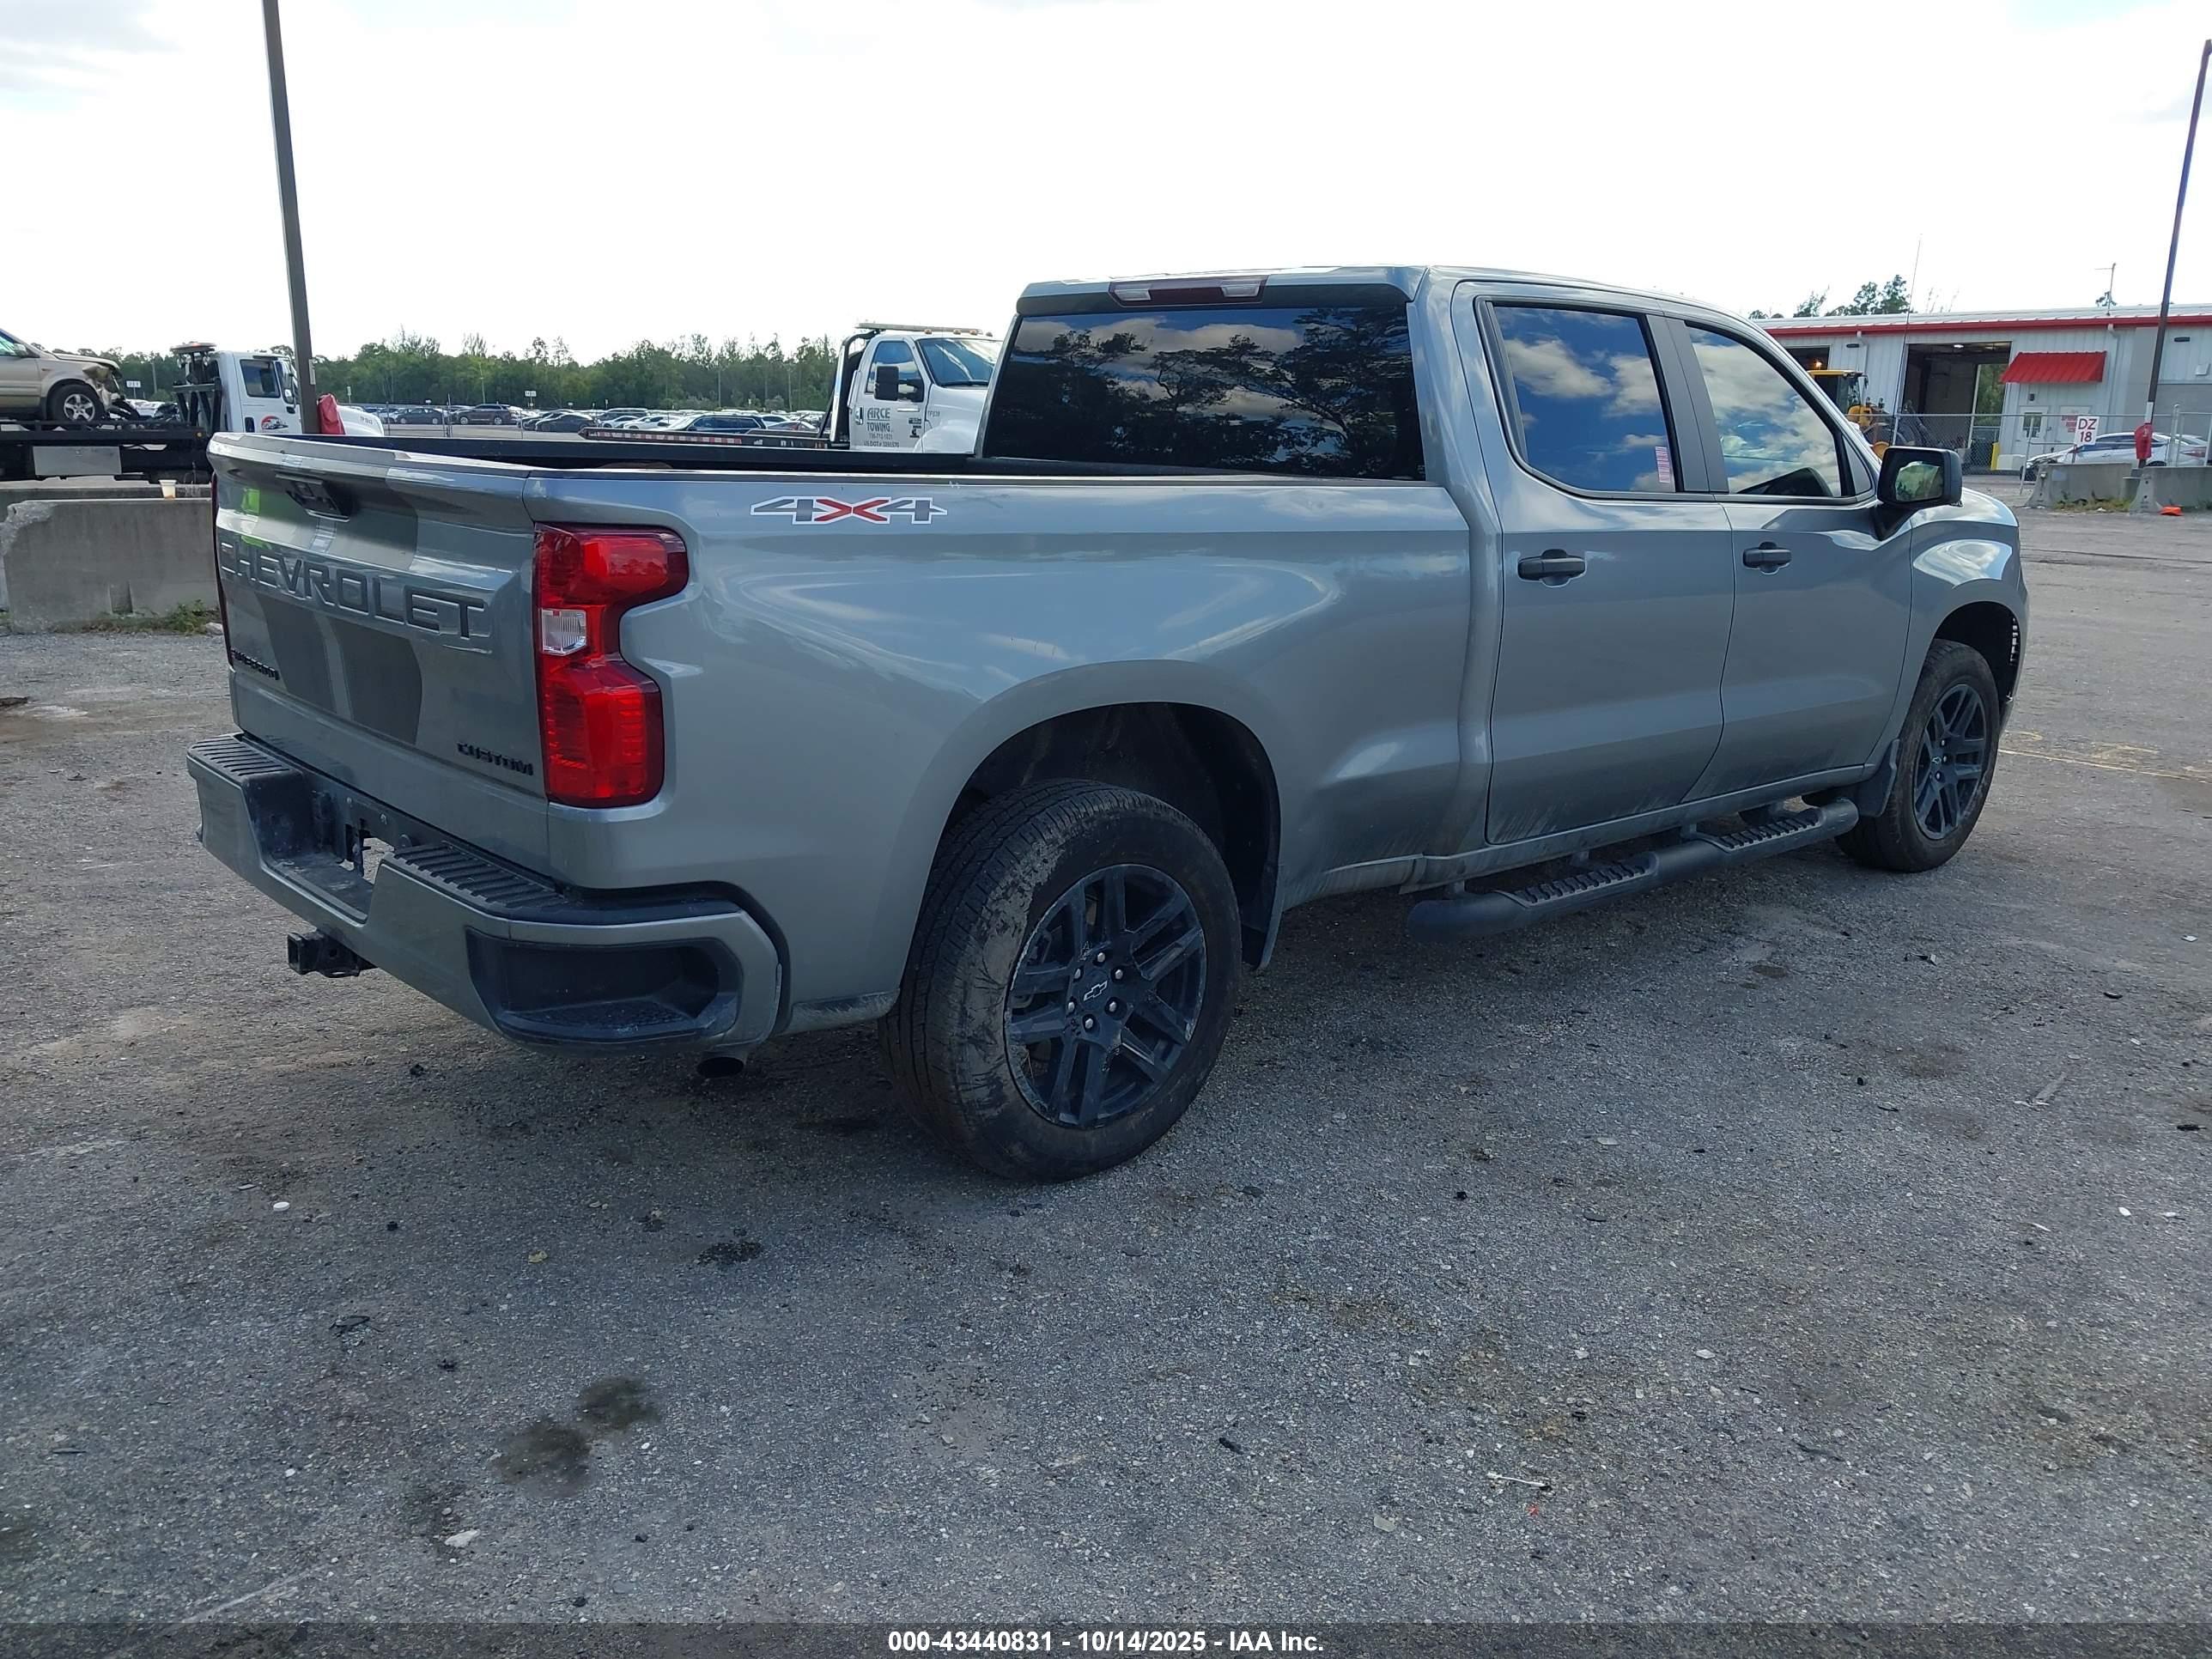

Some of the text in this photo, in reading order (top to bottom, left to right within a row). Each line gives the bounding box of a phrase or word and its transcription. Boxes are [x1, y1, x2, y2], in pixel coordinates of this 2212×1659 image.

[867, 408, 890, 419] ARCE
[866, 422, 890, 432] TOWING
[2078, 418, 2097, 430] DZ
[2080, 431, 2093, 442] 18
[220, 541, 488, 641] CHEVROLET
[457, 741, 534, 776] CUSTOM
